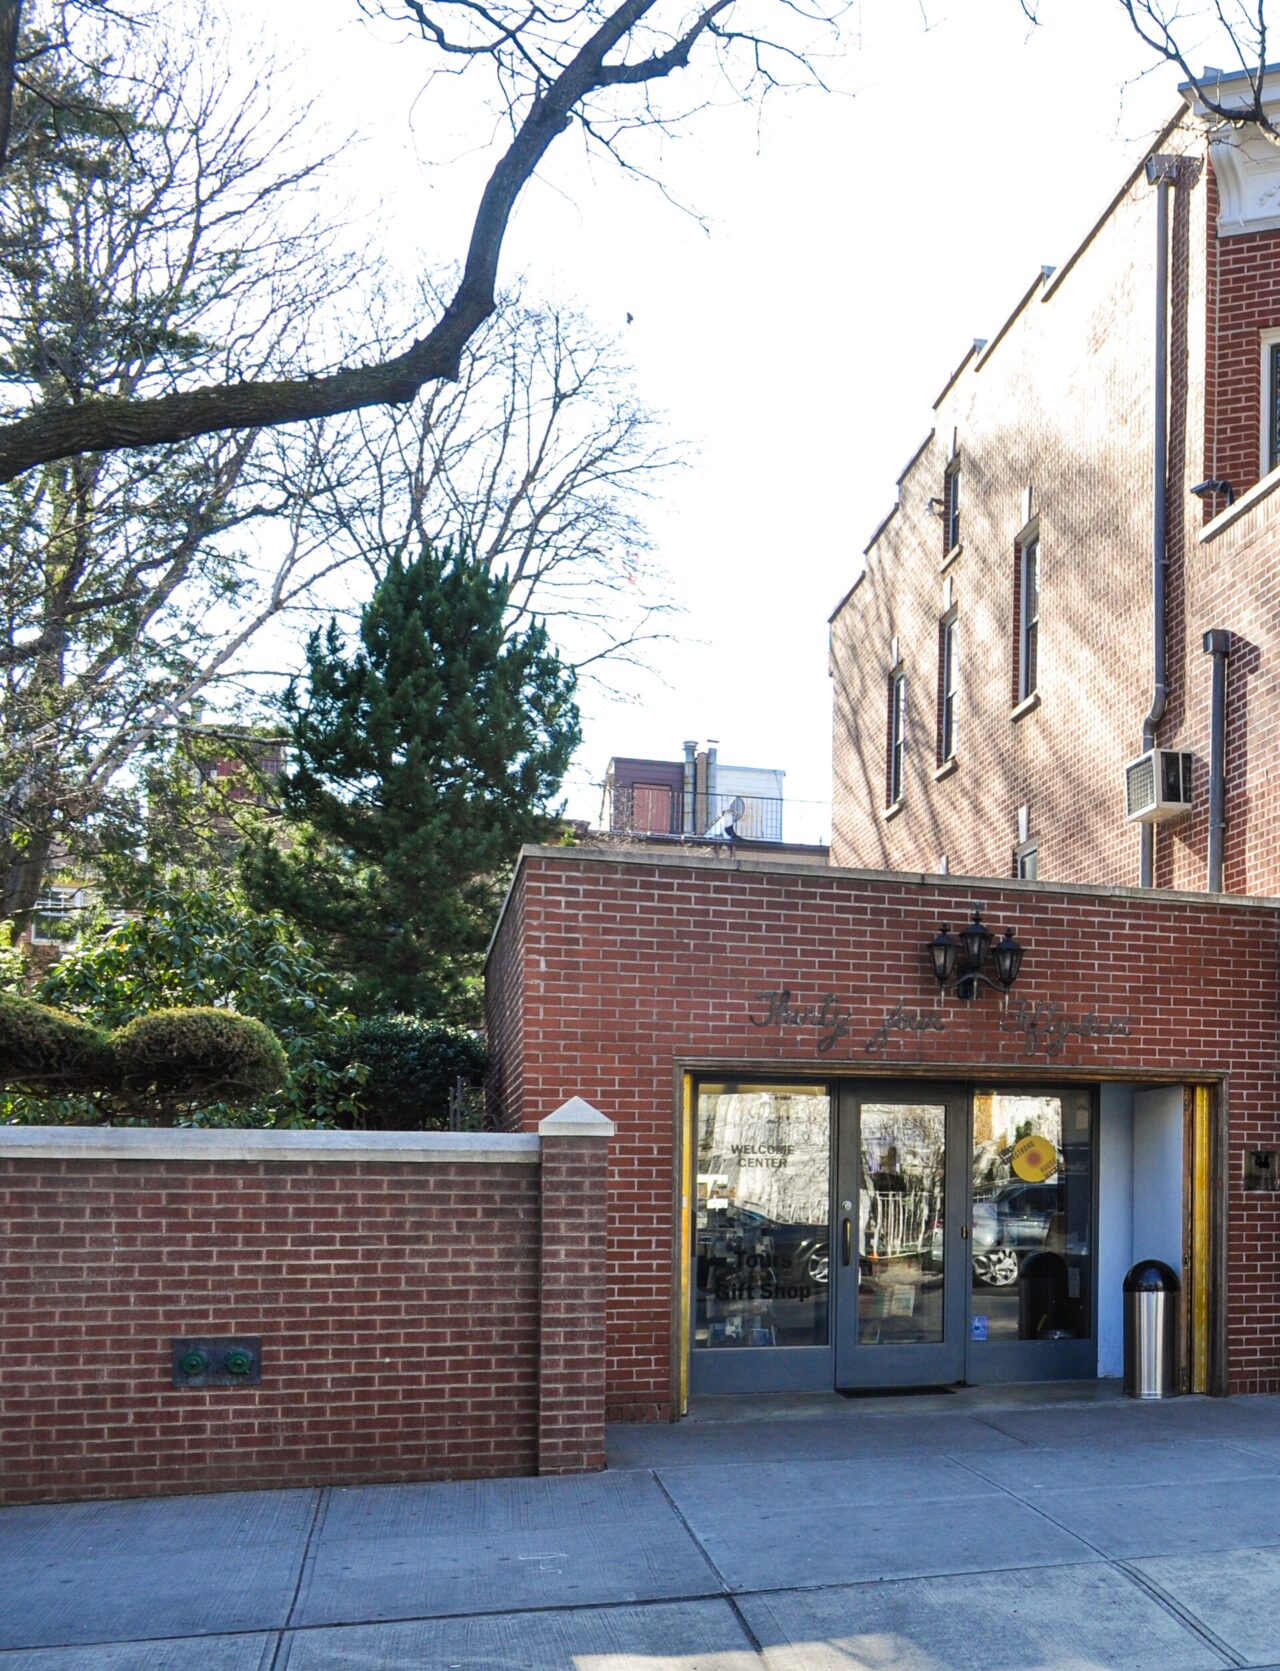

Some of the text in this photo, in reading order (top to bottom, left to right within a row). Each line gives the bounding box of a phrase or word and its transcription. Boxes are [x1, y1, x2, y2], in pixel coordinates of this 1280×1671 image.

[731, 1144, 795, 1155] WELCOME
[738, 1157, 788, 1169] CENTER
[732, 1250, 794, 1268] Tours
[715, 1283, 812, 1302] Gift Shop
